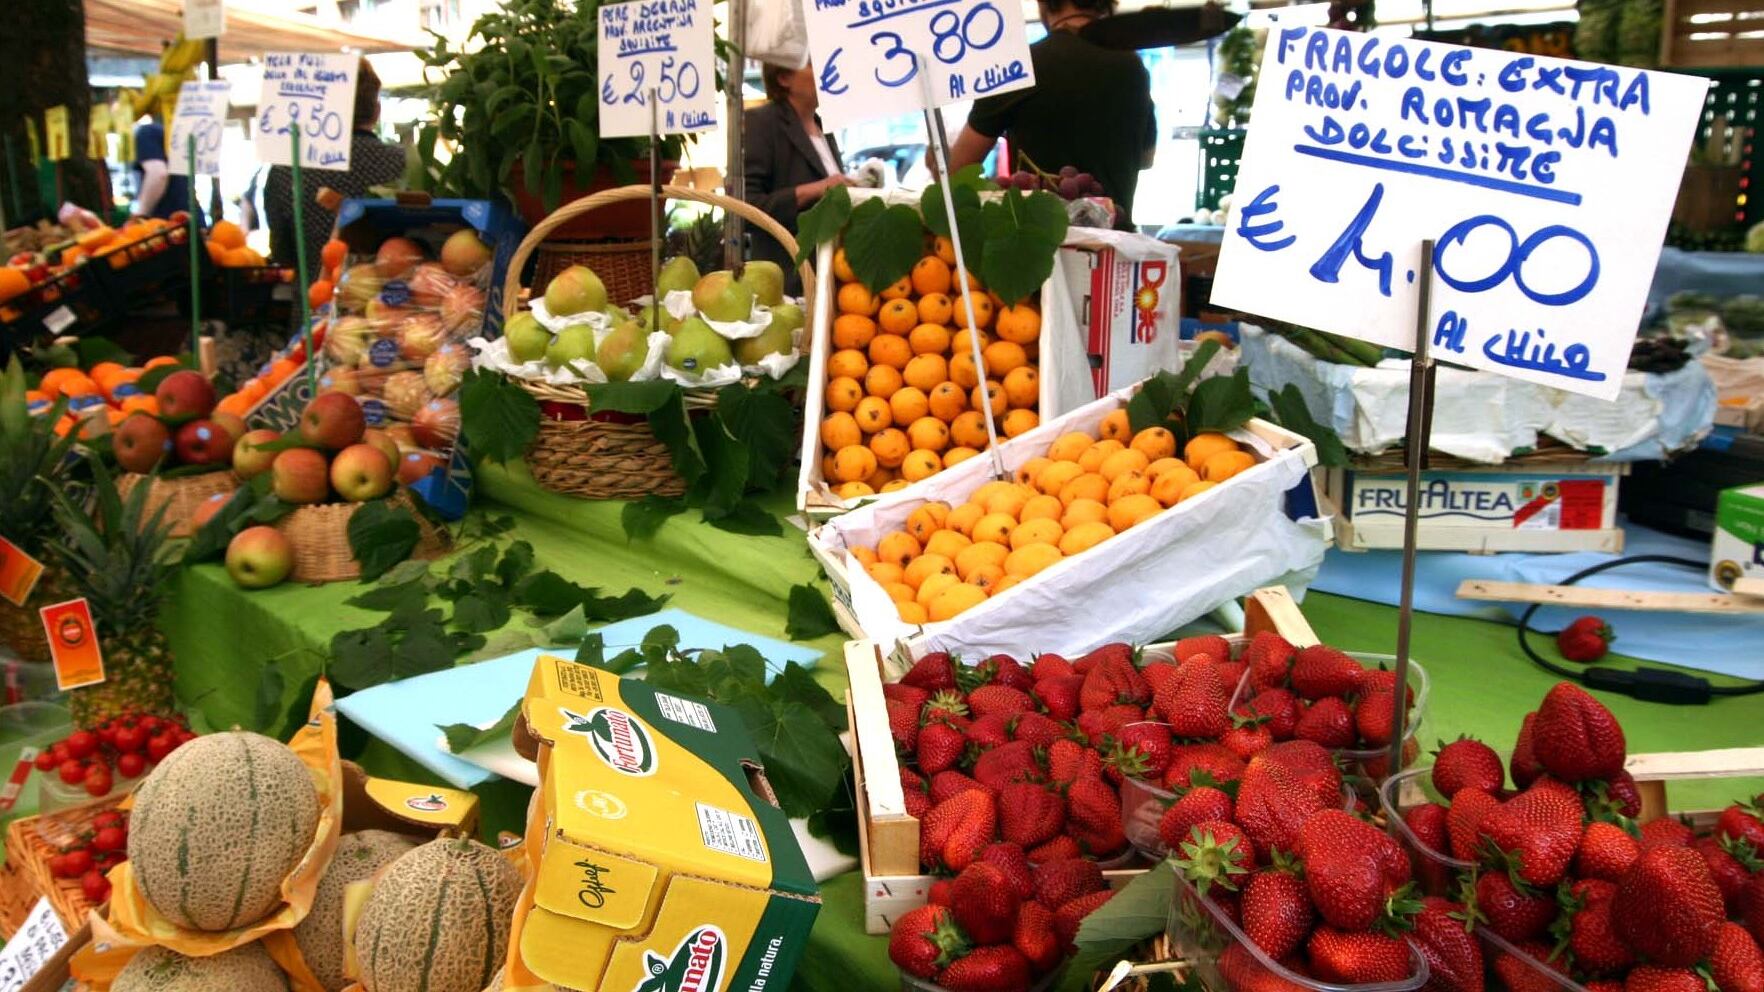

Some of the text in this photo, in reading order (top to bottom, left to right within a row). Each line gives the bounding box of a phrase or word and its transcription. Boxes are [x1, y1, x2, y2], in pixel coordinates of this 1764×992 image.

[1285, 69, 1618, 158] PROV. ROMAGNA
[1498, 57, 1650, 115] EXTRA
[758, 936, 783, 977] natura.
